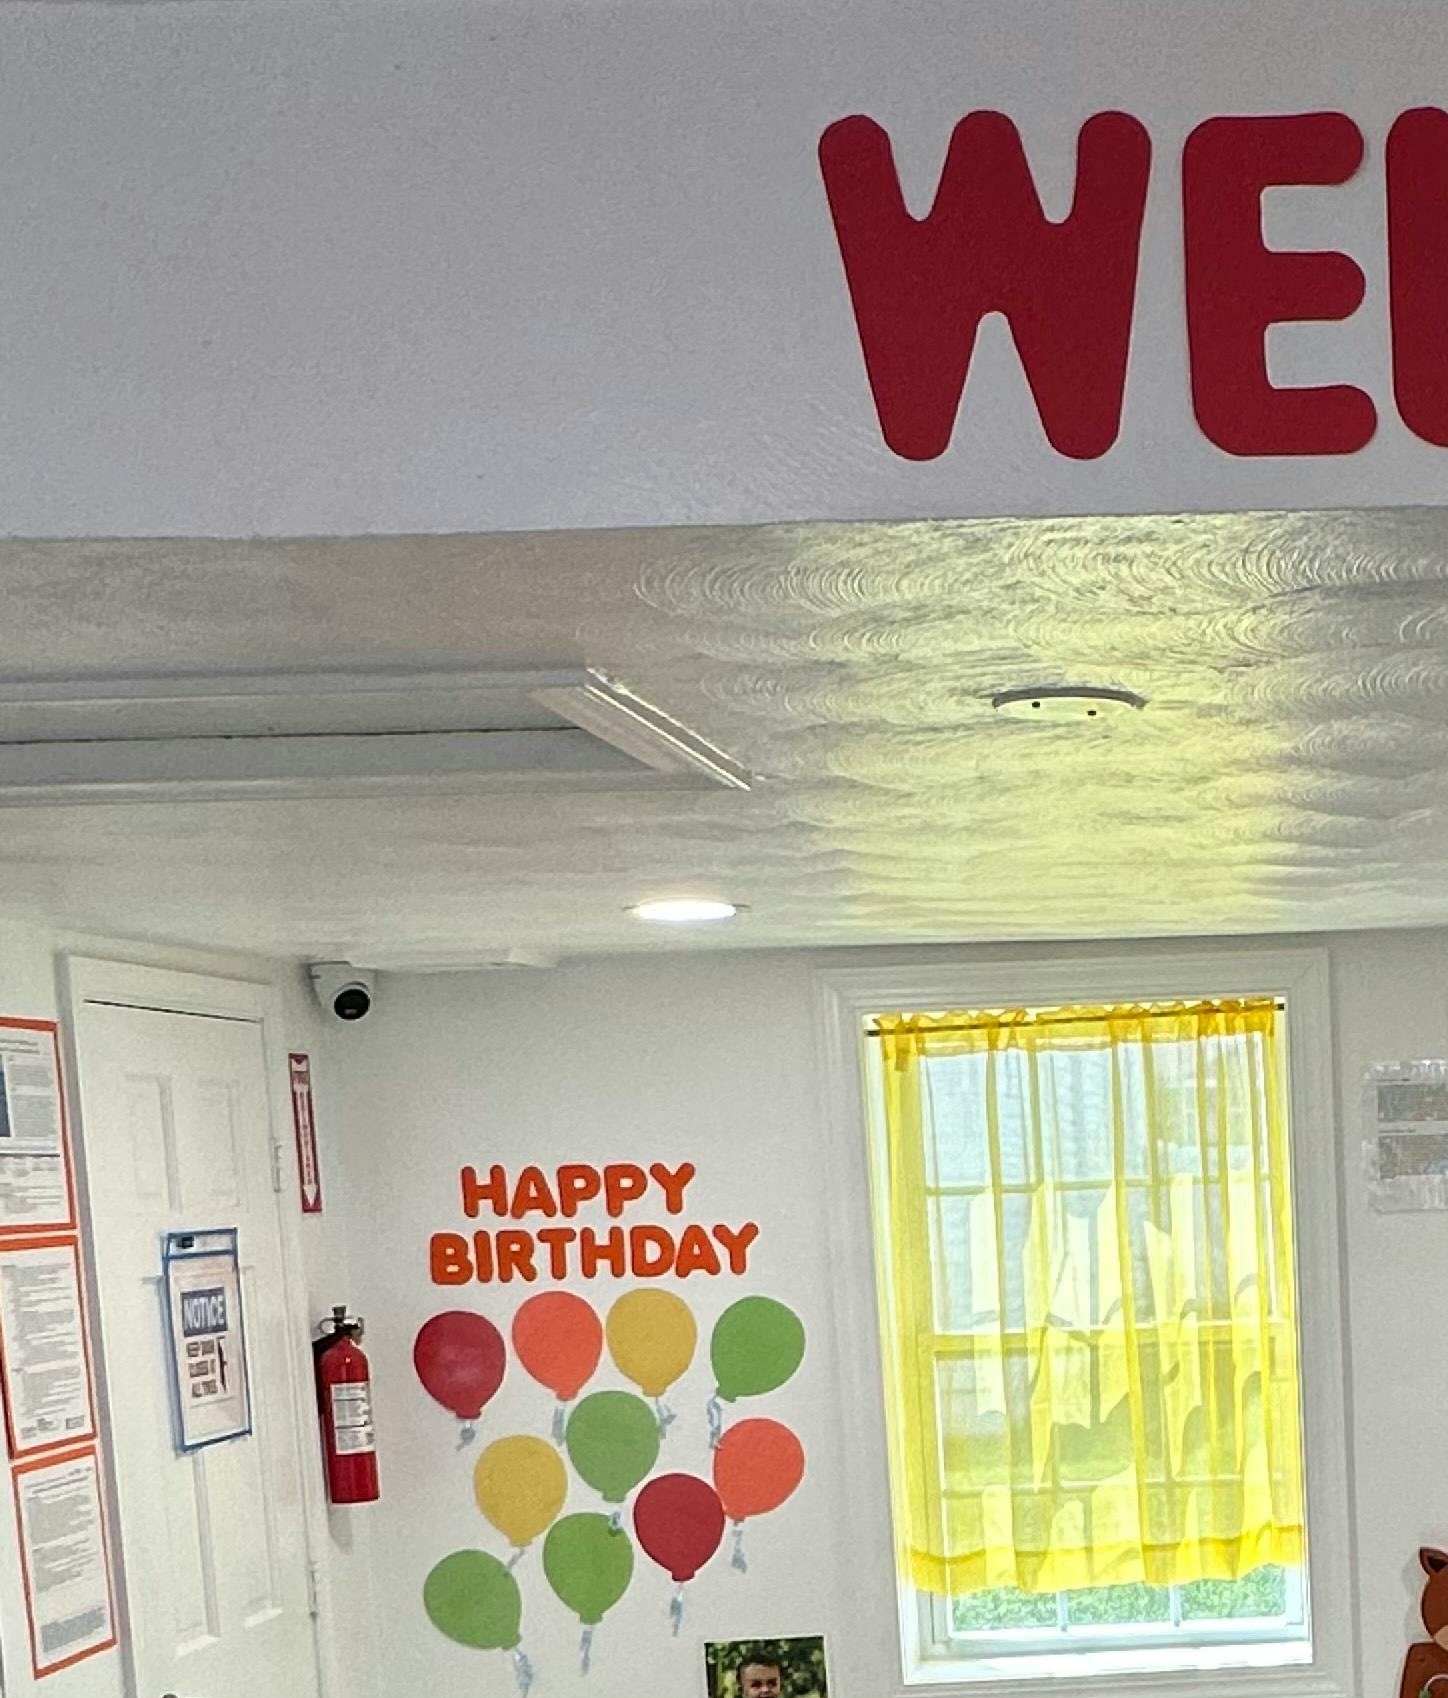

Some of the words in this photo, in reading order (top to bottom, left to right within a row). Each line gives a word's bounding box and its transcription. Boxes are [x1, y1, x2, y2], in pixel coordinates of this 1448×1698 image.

[460, 1162, 696, 1219] HAPPY
[430, 1222, 759, 1285] BIRTHDAY
[184, 1295, 226, 1331] NOTICE
